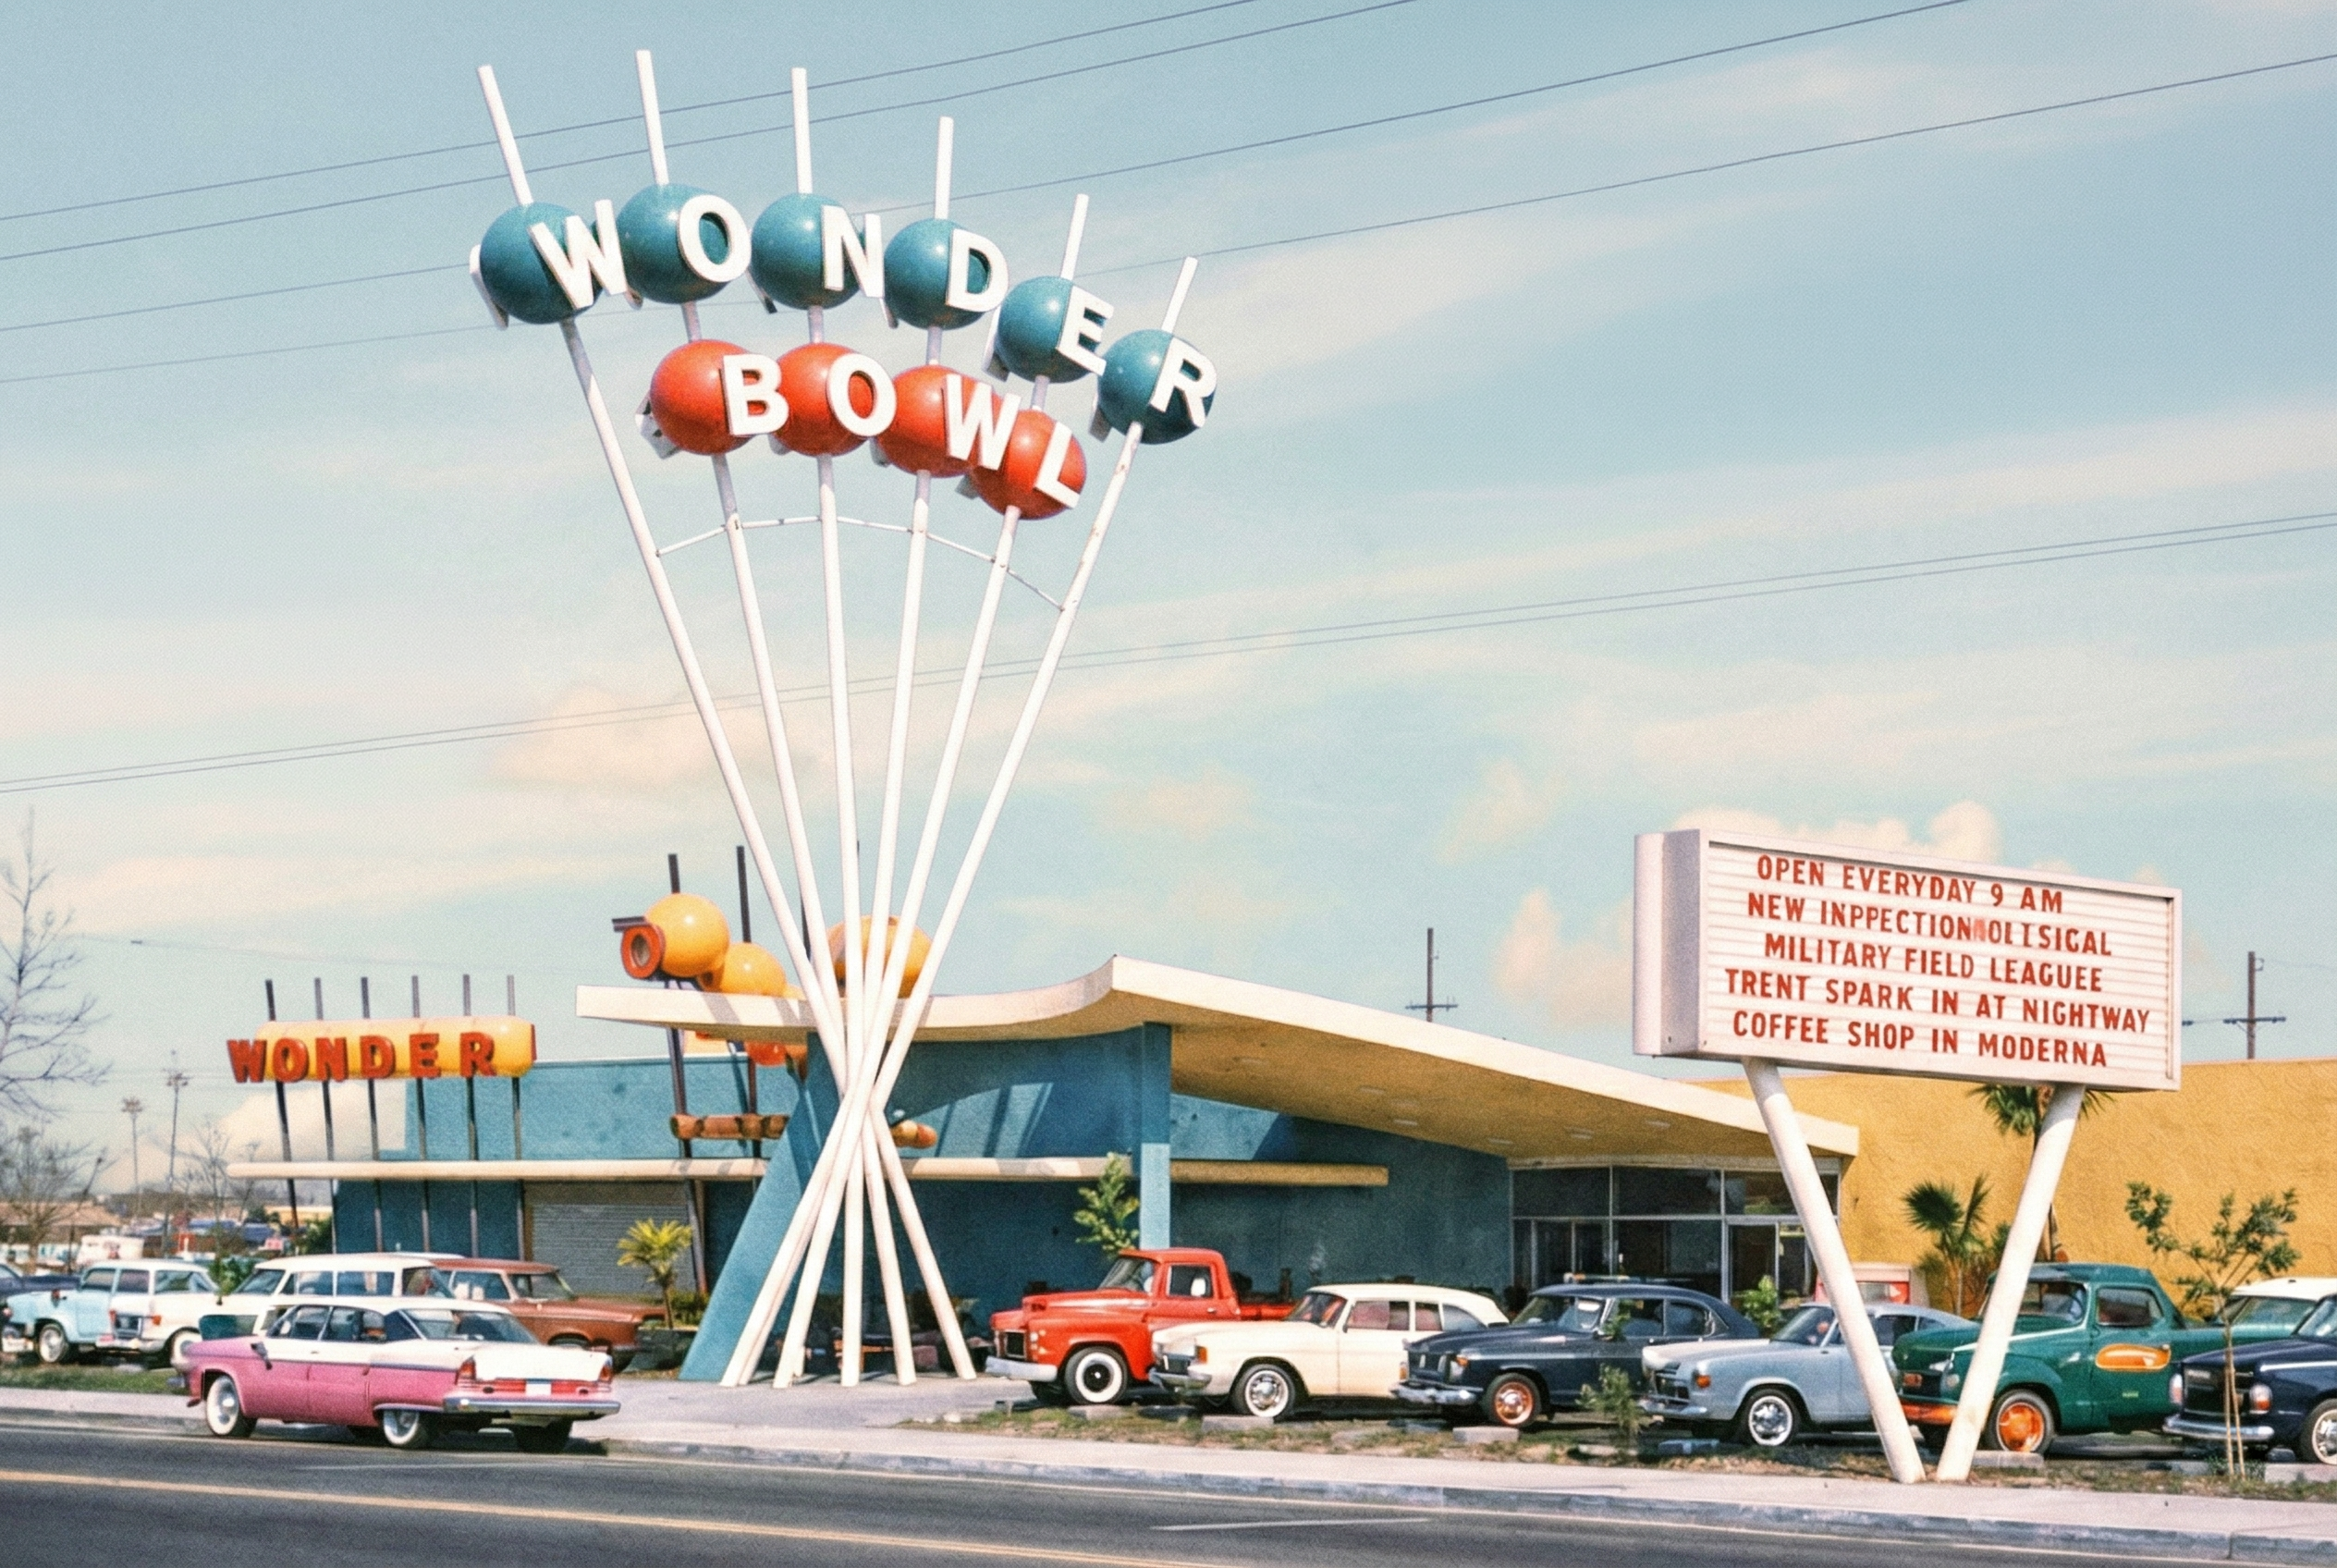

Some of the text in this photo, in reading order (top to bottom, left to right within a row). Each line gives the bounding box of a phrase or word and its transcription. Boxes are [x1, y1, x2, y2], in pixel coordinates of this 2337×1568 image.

[530, 193, 1217, 428] WONDER
[721, 352, 1081, 510] BOWL
[1746, 890, 1805, 923] NEW
[1756, 853, 2063, 914] OPEN EVERYDAY 9 AM
[1764, 932, 2102, 994] MILITARY FIELD LEAGUEE
[1725, 967, 2150, 1035] TRENT SPARK IN AT NIGHTWAY
[226, 1031, 497, 1084] WONDER
[1731, 1008, 2108, 1068] COFFEE SHOP IN MODERNA
